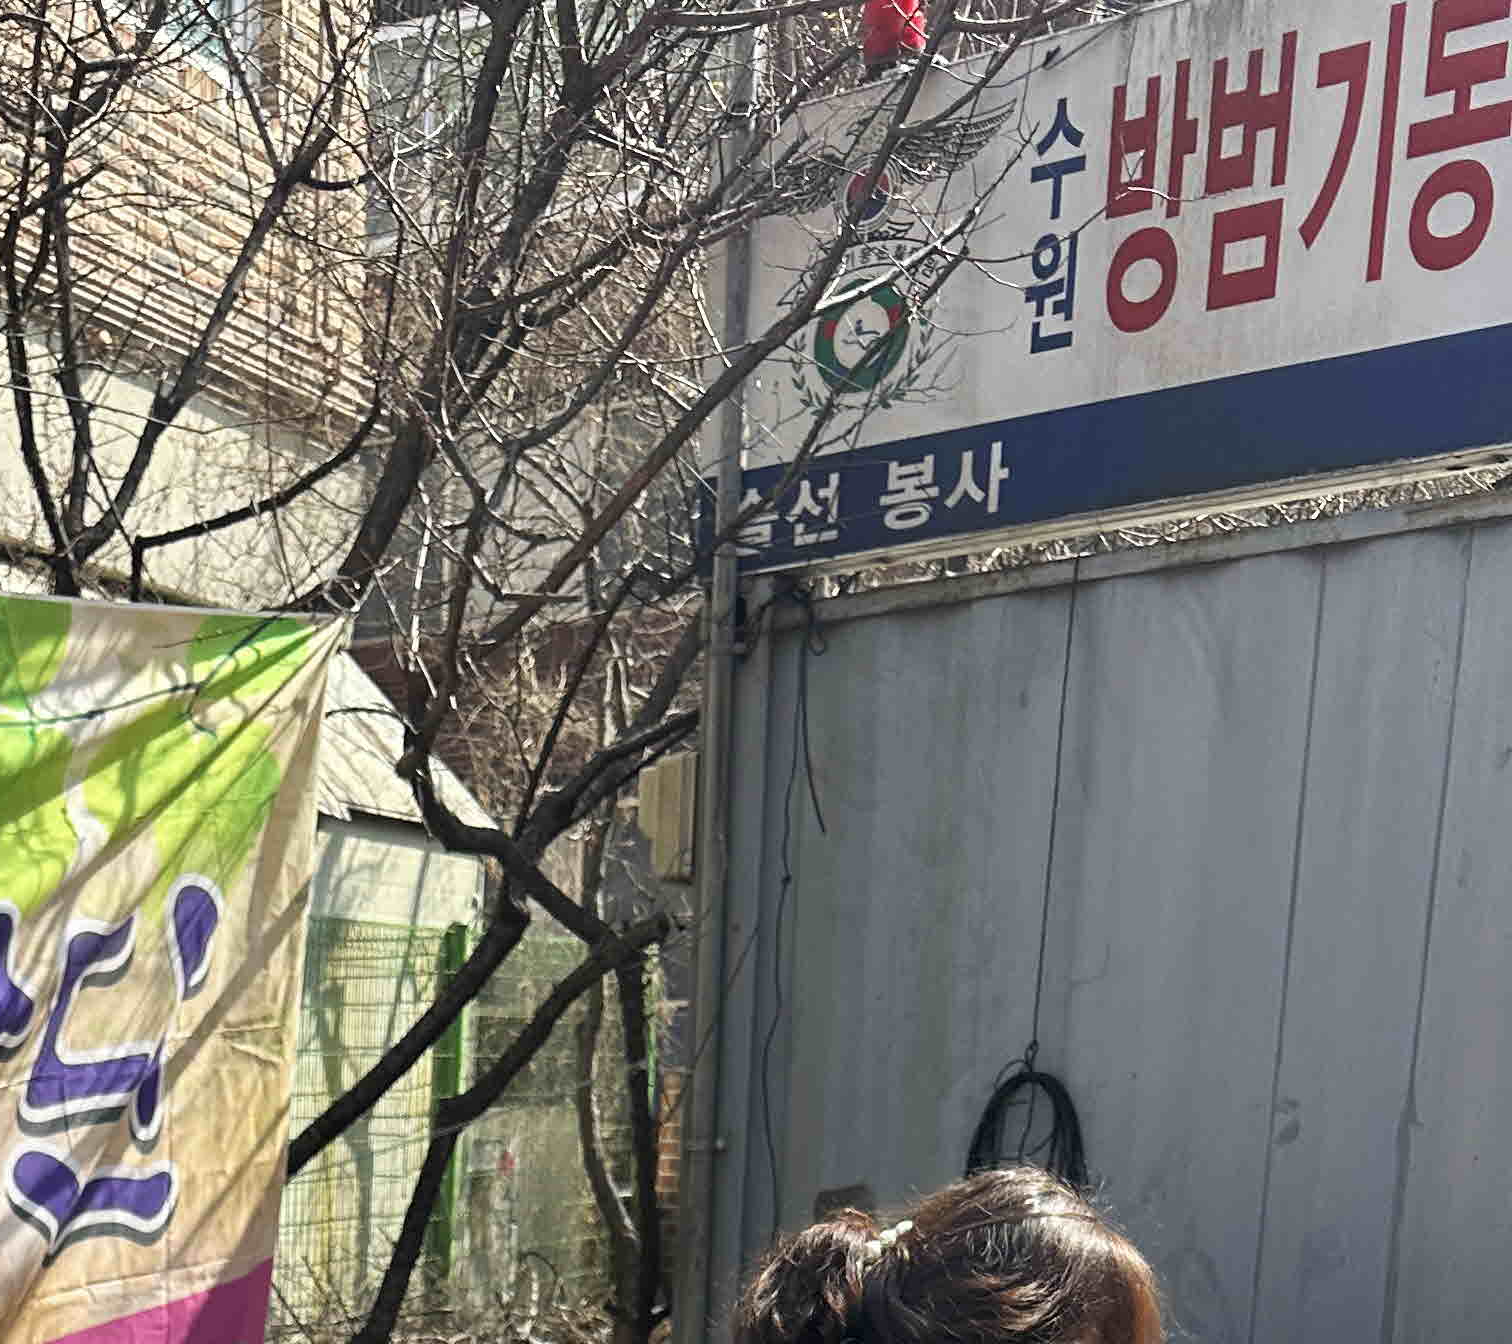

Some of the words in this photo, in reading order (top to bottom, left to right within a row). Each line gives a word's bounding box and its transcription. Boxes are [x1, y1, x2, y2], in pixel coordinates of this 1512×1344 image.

[1024, 97, 1087, 354] 수원
[1105, 0, 1512, 333] 방범기동
[879, 440, 1010, 530] 봉사
